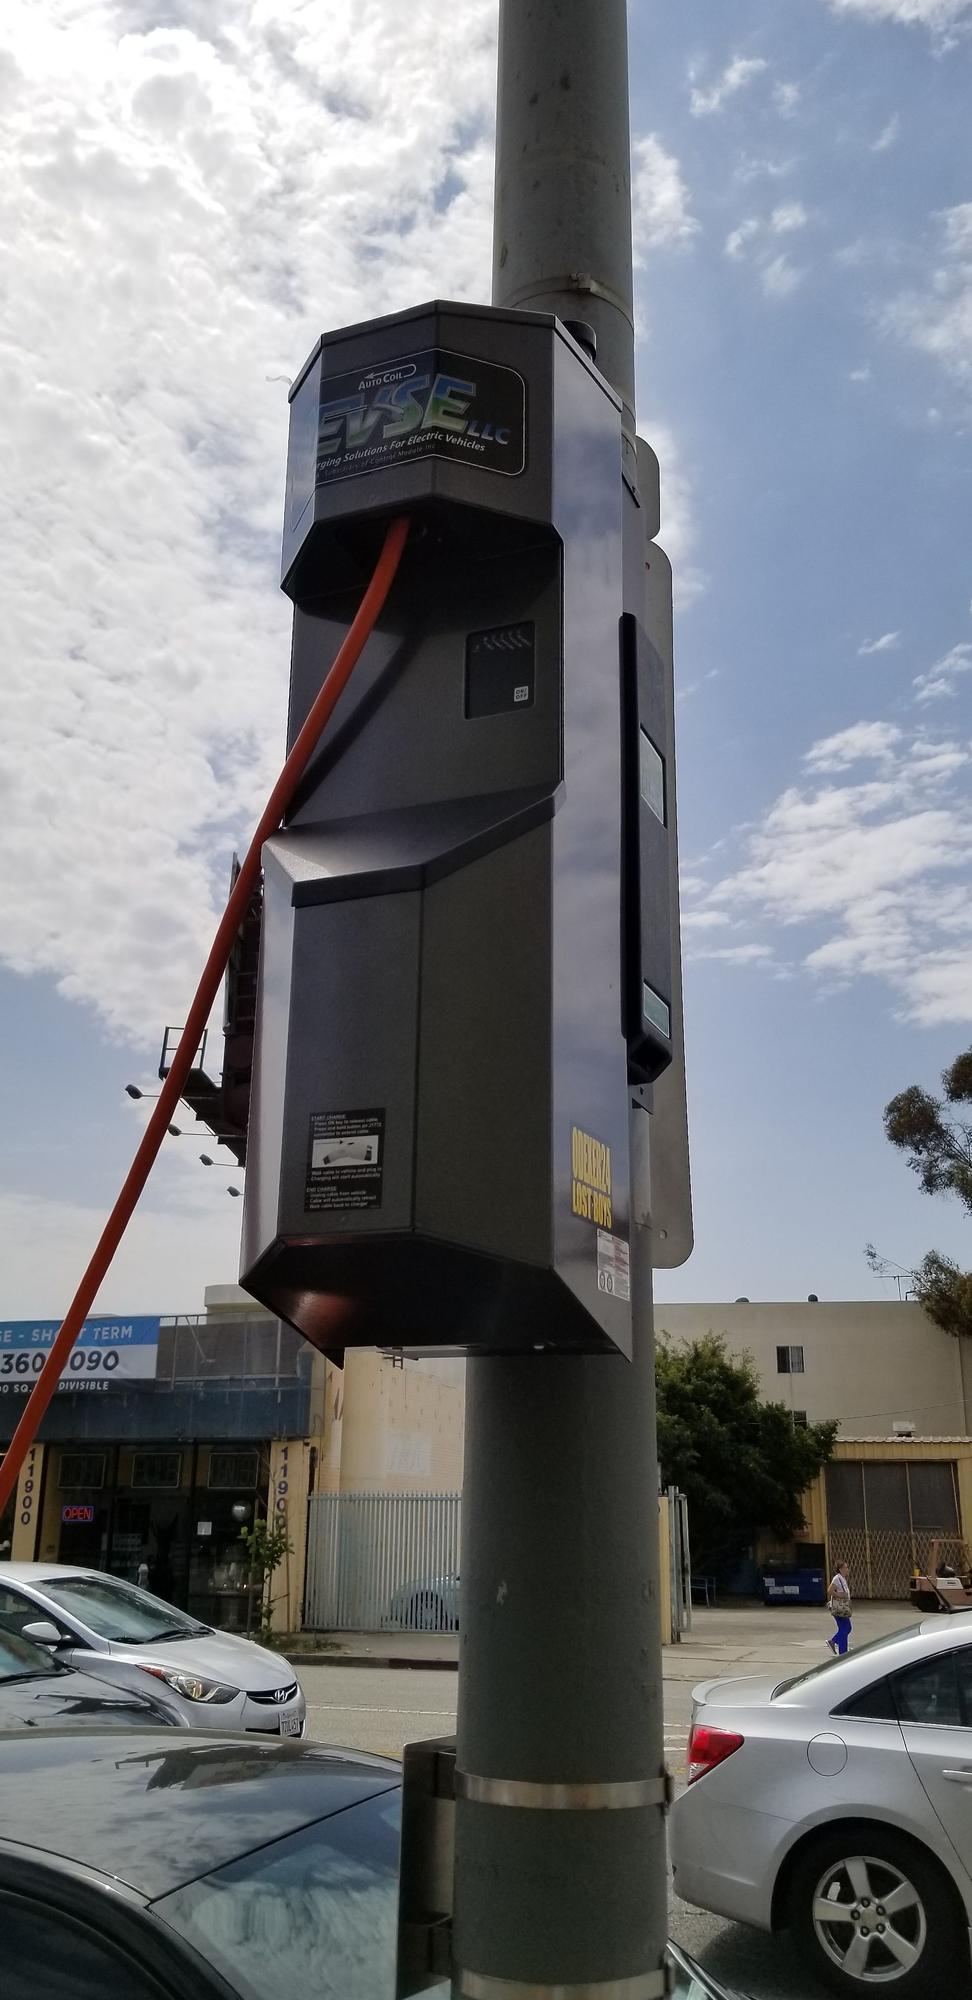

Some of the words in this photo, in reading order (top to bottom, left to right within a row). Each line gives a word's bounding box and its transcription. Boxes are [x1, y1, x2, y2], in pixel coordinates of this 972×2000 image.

[318, 372, 477, 455] EVSE
[466, 420, 512, 445] LLC
[317, 456, 341, 471] rging
[343, 444, 388, 463] Solutions
[390, 438, 406, 450] For
[407, 431, 444, 445] Electric
[445, 434, 485, 452] Vehicles
[572, 1179, 592, 1219] LOST
[593, 1190, 612, 1230] BOYS
[93, 1325, 133, 1341] TERM
[58, 1381, 110, 1391] DIVISIBLE
[21, 1447, 36, 1525] 11900
[63, 1507, 92, 1520] OPEN
